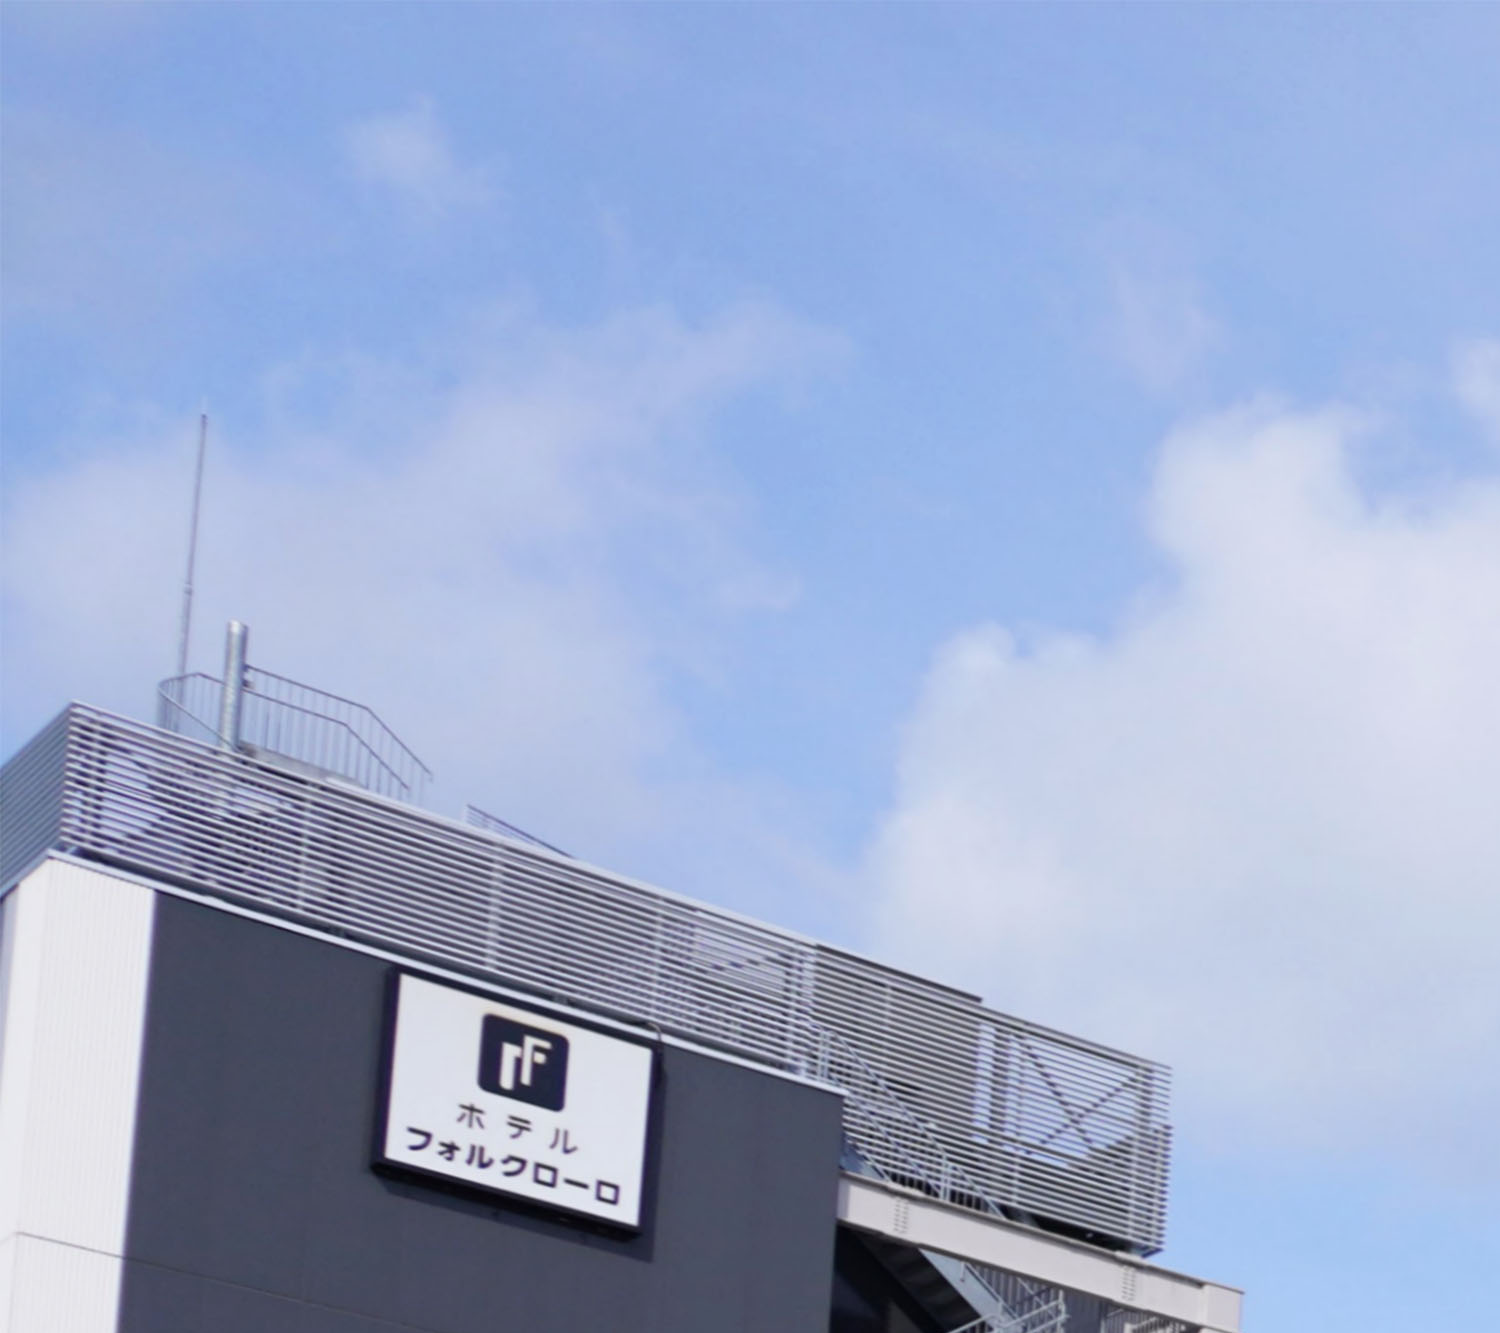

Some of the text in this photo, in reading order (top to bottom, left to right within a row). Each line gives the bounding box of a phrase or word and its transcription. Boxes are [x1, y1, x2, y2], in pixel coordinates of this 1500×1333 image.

[456, 1102, 578, 1155] ホテル
[405, 1126, 620, 1206] フォルクローロ
